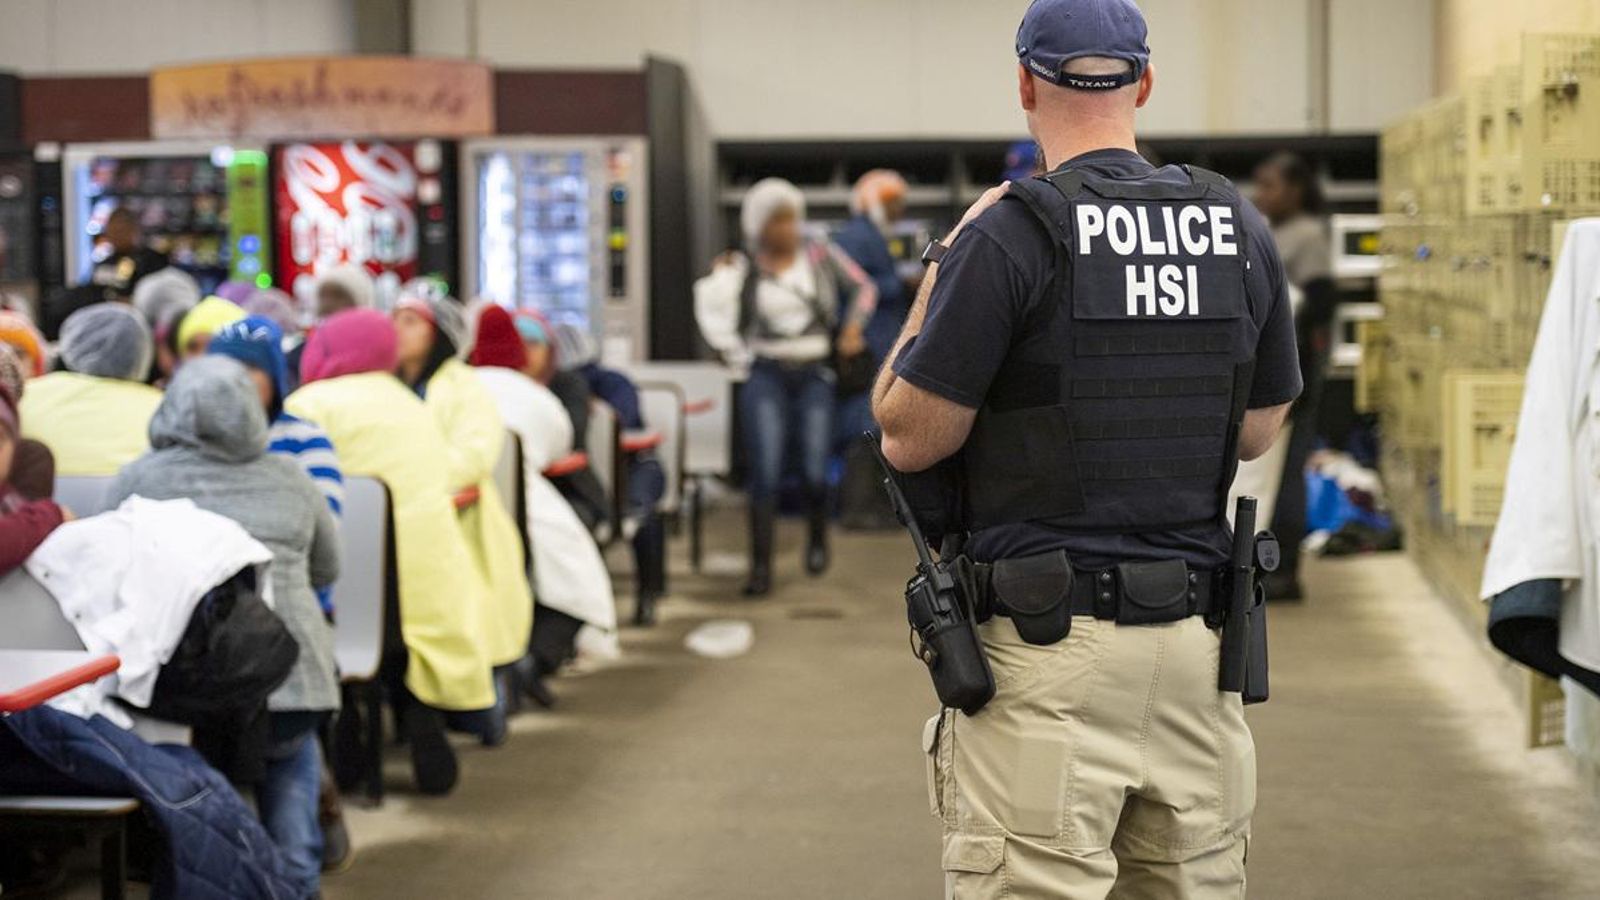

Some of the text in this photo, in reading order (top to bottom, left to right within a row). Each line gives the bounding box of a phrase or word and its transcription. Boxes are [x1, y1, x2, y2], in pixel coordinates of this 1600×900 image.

[1029, 58, 1056, 79] Reebok
[1069, 79, 1117, 88] TEXANS
[1076, 204, 1238, 256] POLICE
[1125, 264, 1199, 316] HSI
